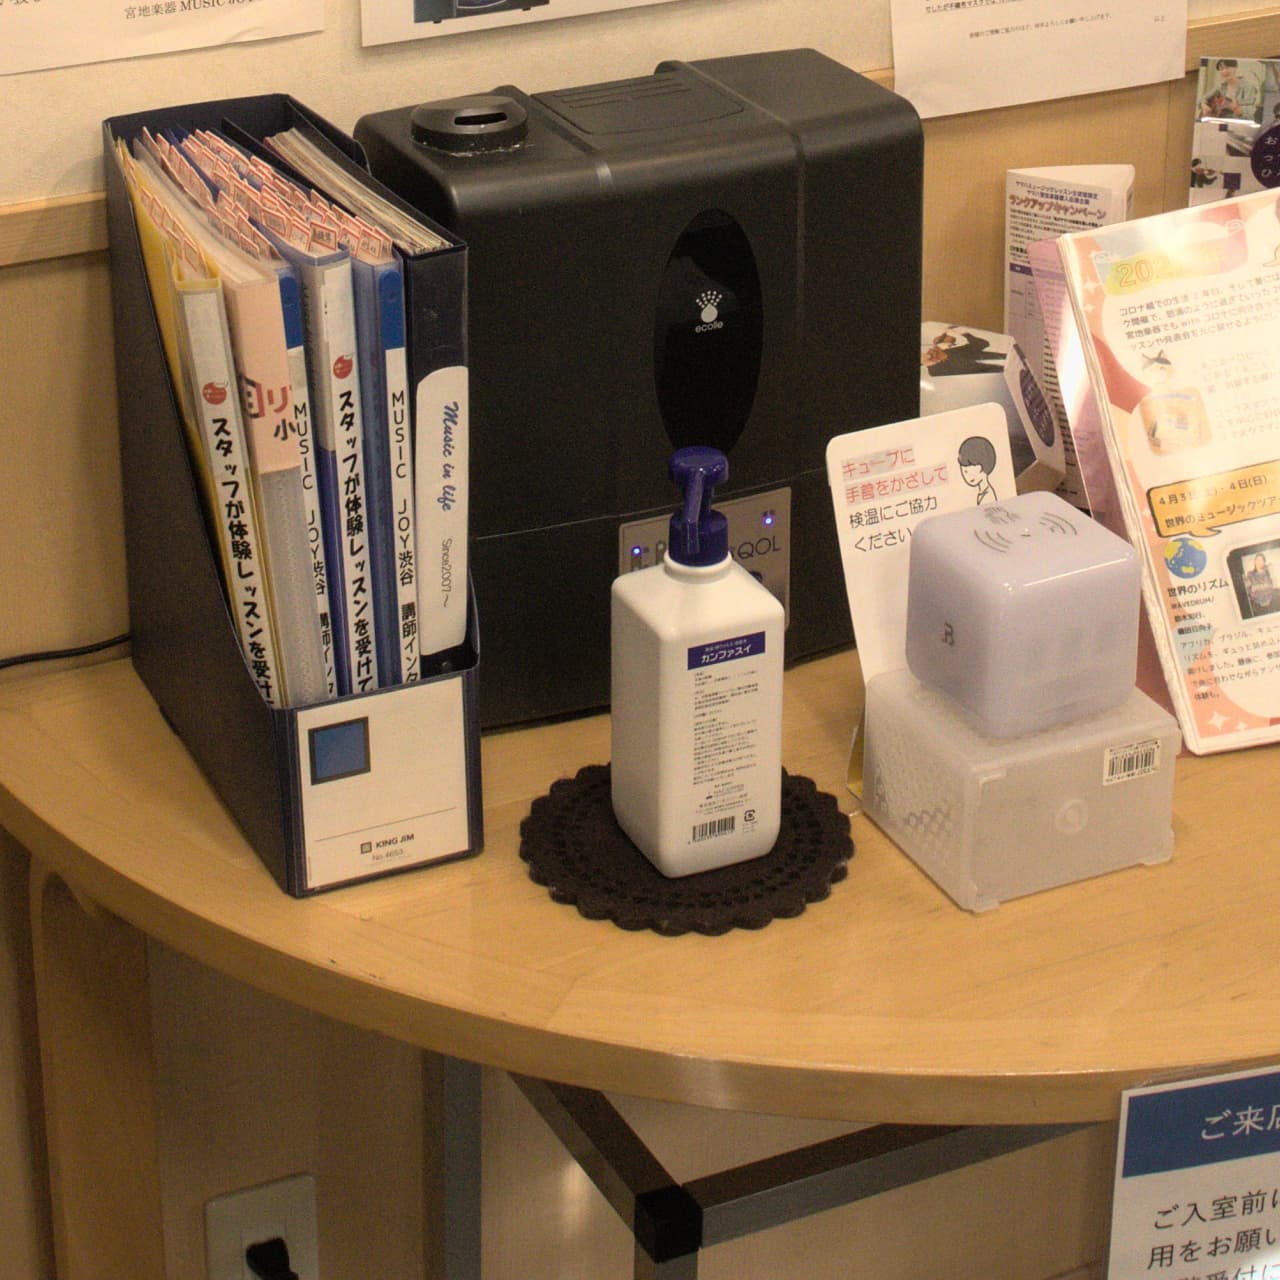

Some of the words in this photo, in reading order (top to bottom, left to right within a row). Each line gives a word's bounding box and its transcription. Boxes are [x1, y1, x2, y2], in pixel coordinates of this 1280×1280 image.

[123, 0, 177, 20] 宮地楽器
[392, 390, 406, 479] MUSIC
[443, 401, 458, 458] Music
[437, 484, 456, 512] life
[847, 466, 948, 503] 手首をかざして
[850, 496, 938, 528] 検温にご協力
[1167, 577, 1229, 598] 世界のリズム
[700, 644, 752, 664] カンファスイ
[376, 838, 398, 848] KING
[400, 834, 414, 842] JIM
